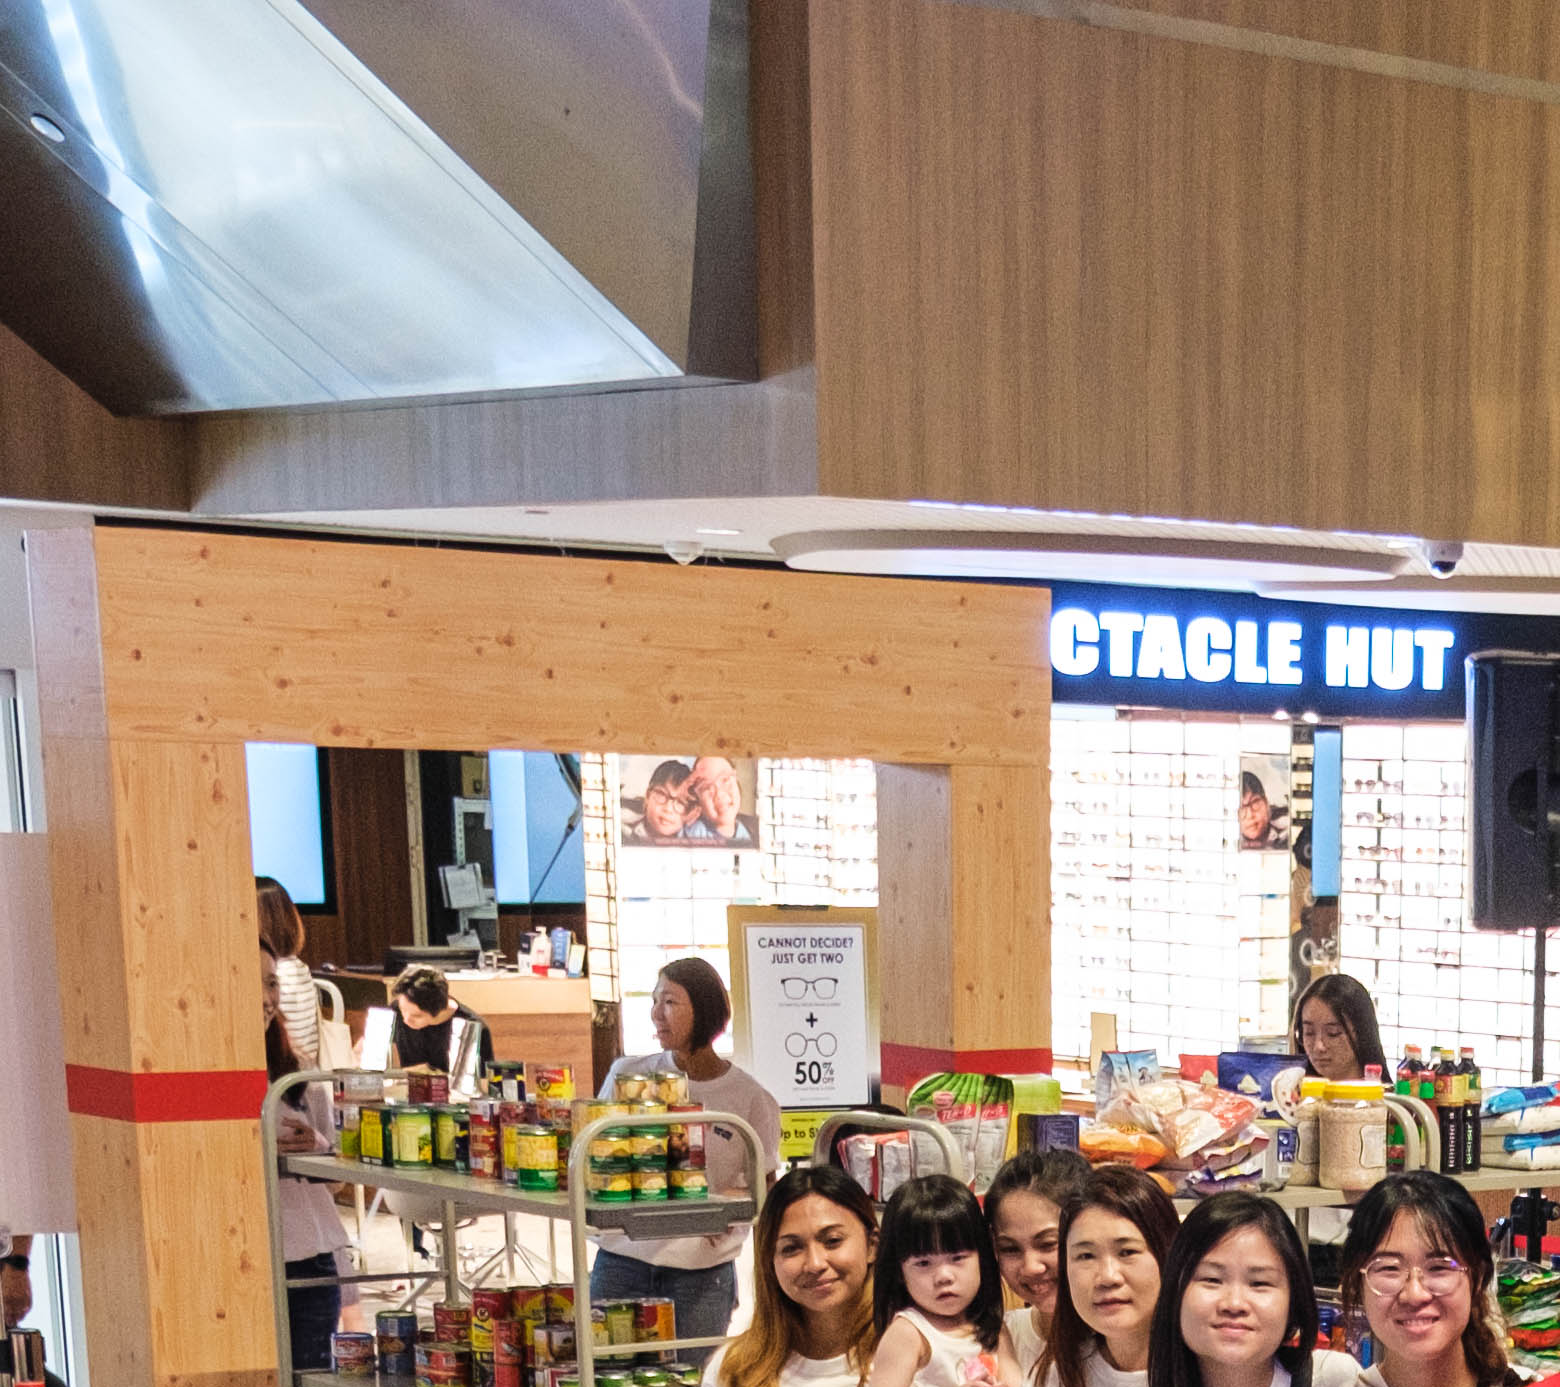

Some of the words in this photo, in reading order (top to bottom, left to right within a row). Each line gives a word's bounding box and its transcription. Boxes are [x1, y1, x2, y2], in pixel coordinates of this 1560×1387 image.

[1324, 625, 1455, 692] HUT
[758, 937, 807, 949] CANNOT
[810, 937, 854, 949] DECIDE?
[771, 953, 794, 964] JUST
[798, 953, 817, 964] GET
[820, 953, 844, 964] TWO
